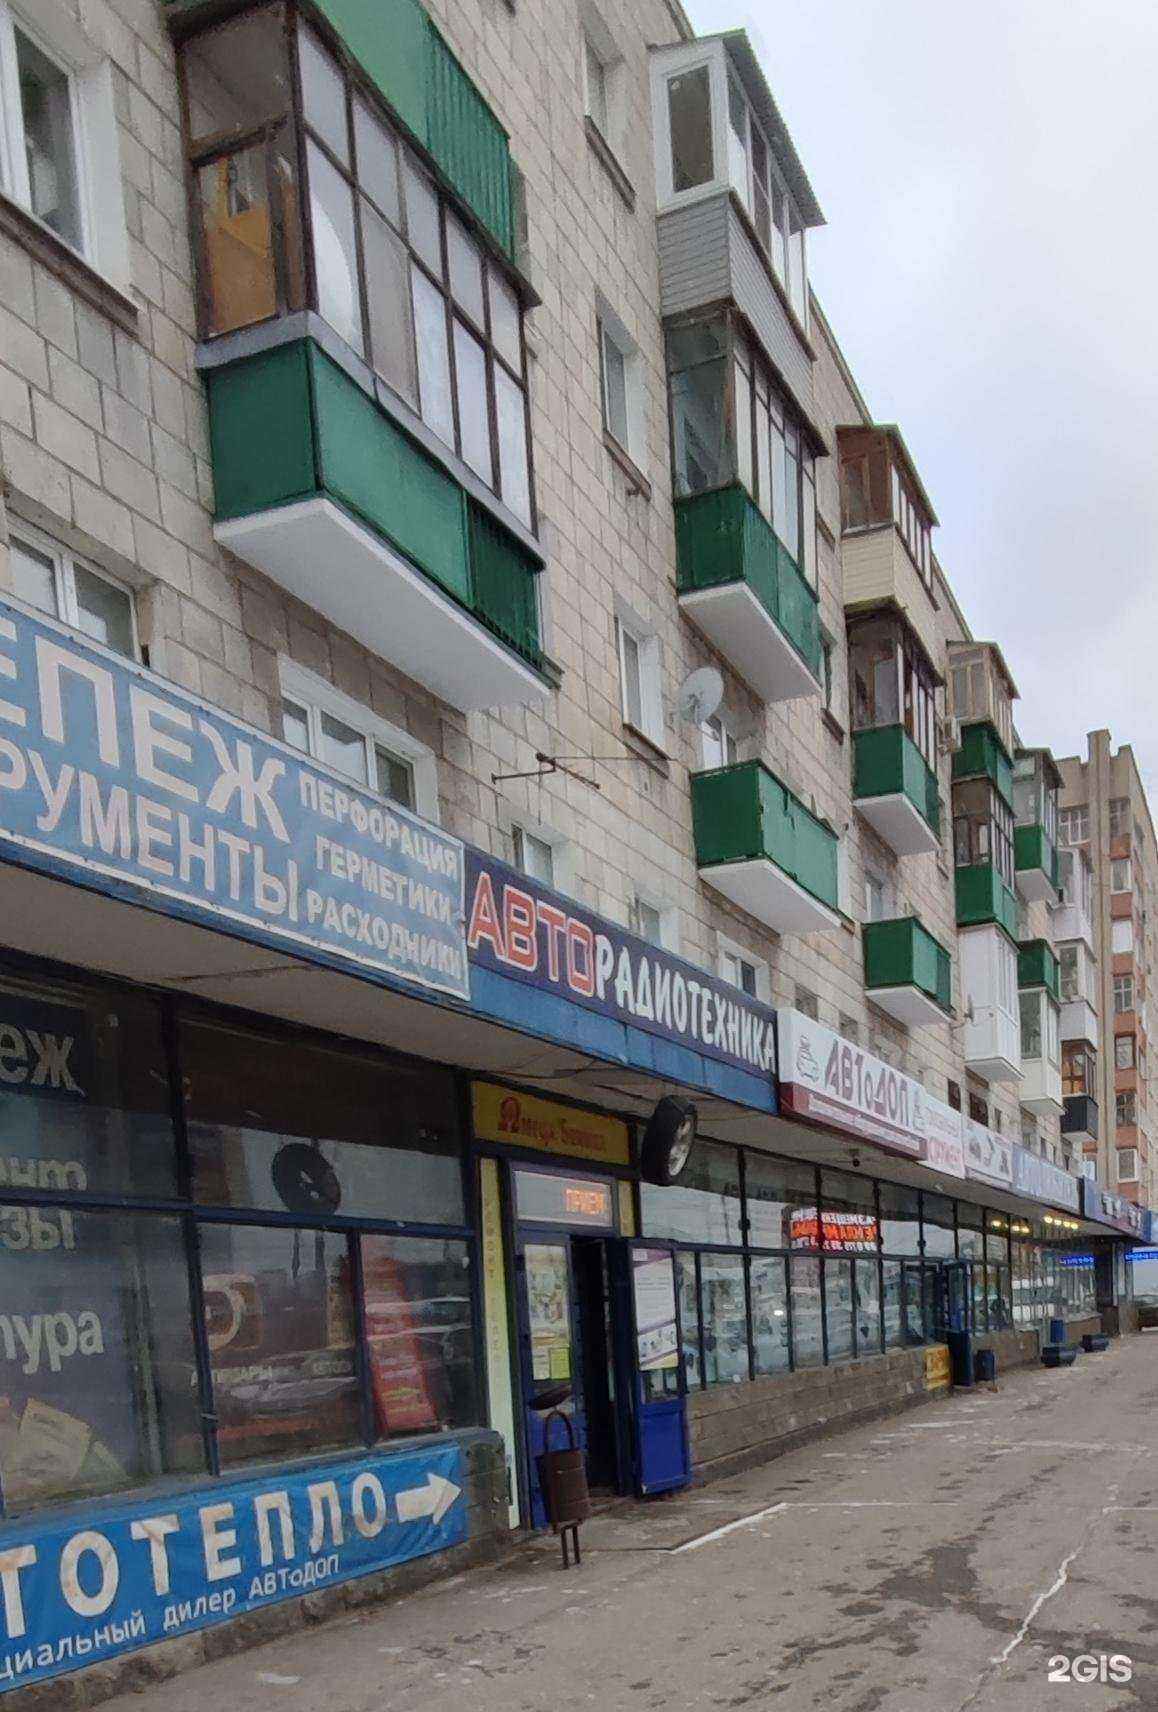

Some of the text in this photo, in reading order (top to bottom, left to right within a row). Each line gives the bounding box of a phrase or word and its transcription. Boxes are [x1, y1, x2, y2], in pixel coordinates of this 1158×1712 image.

[299, 770, 458, 881] ПЕРФОРАЦИЯ
[315, 834, 453, 926] ГЕРМЕТИКИ
[306, 888, 463, 981] РАСХОДНИКИ
[163, 1586, 236, 1632] дилер
